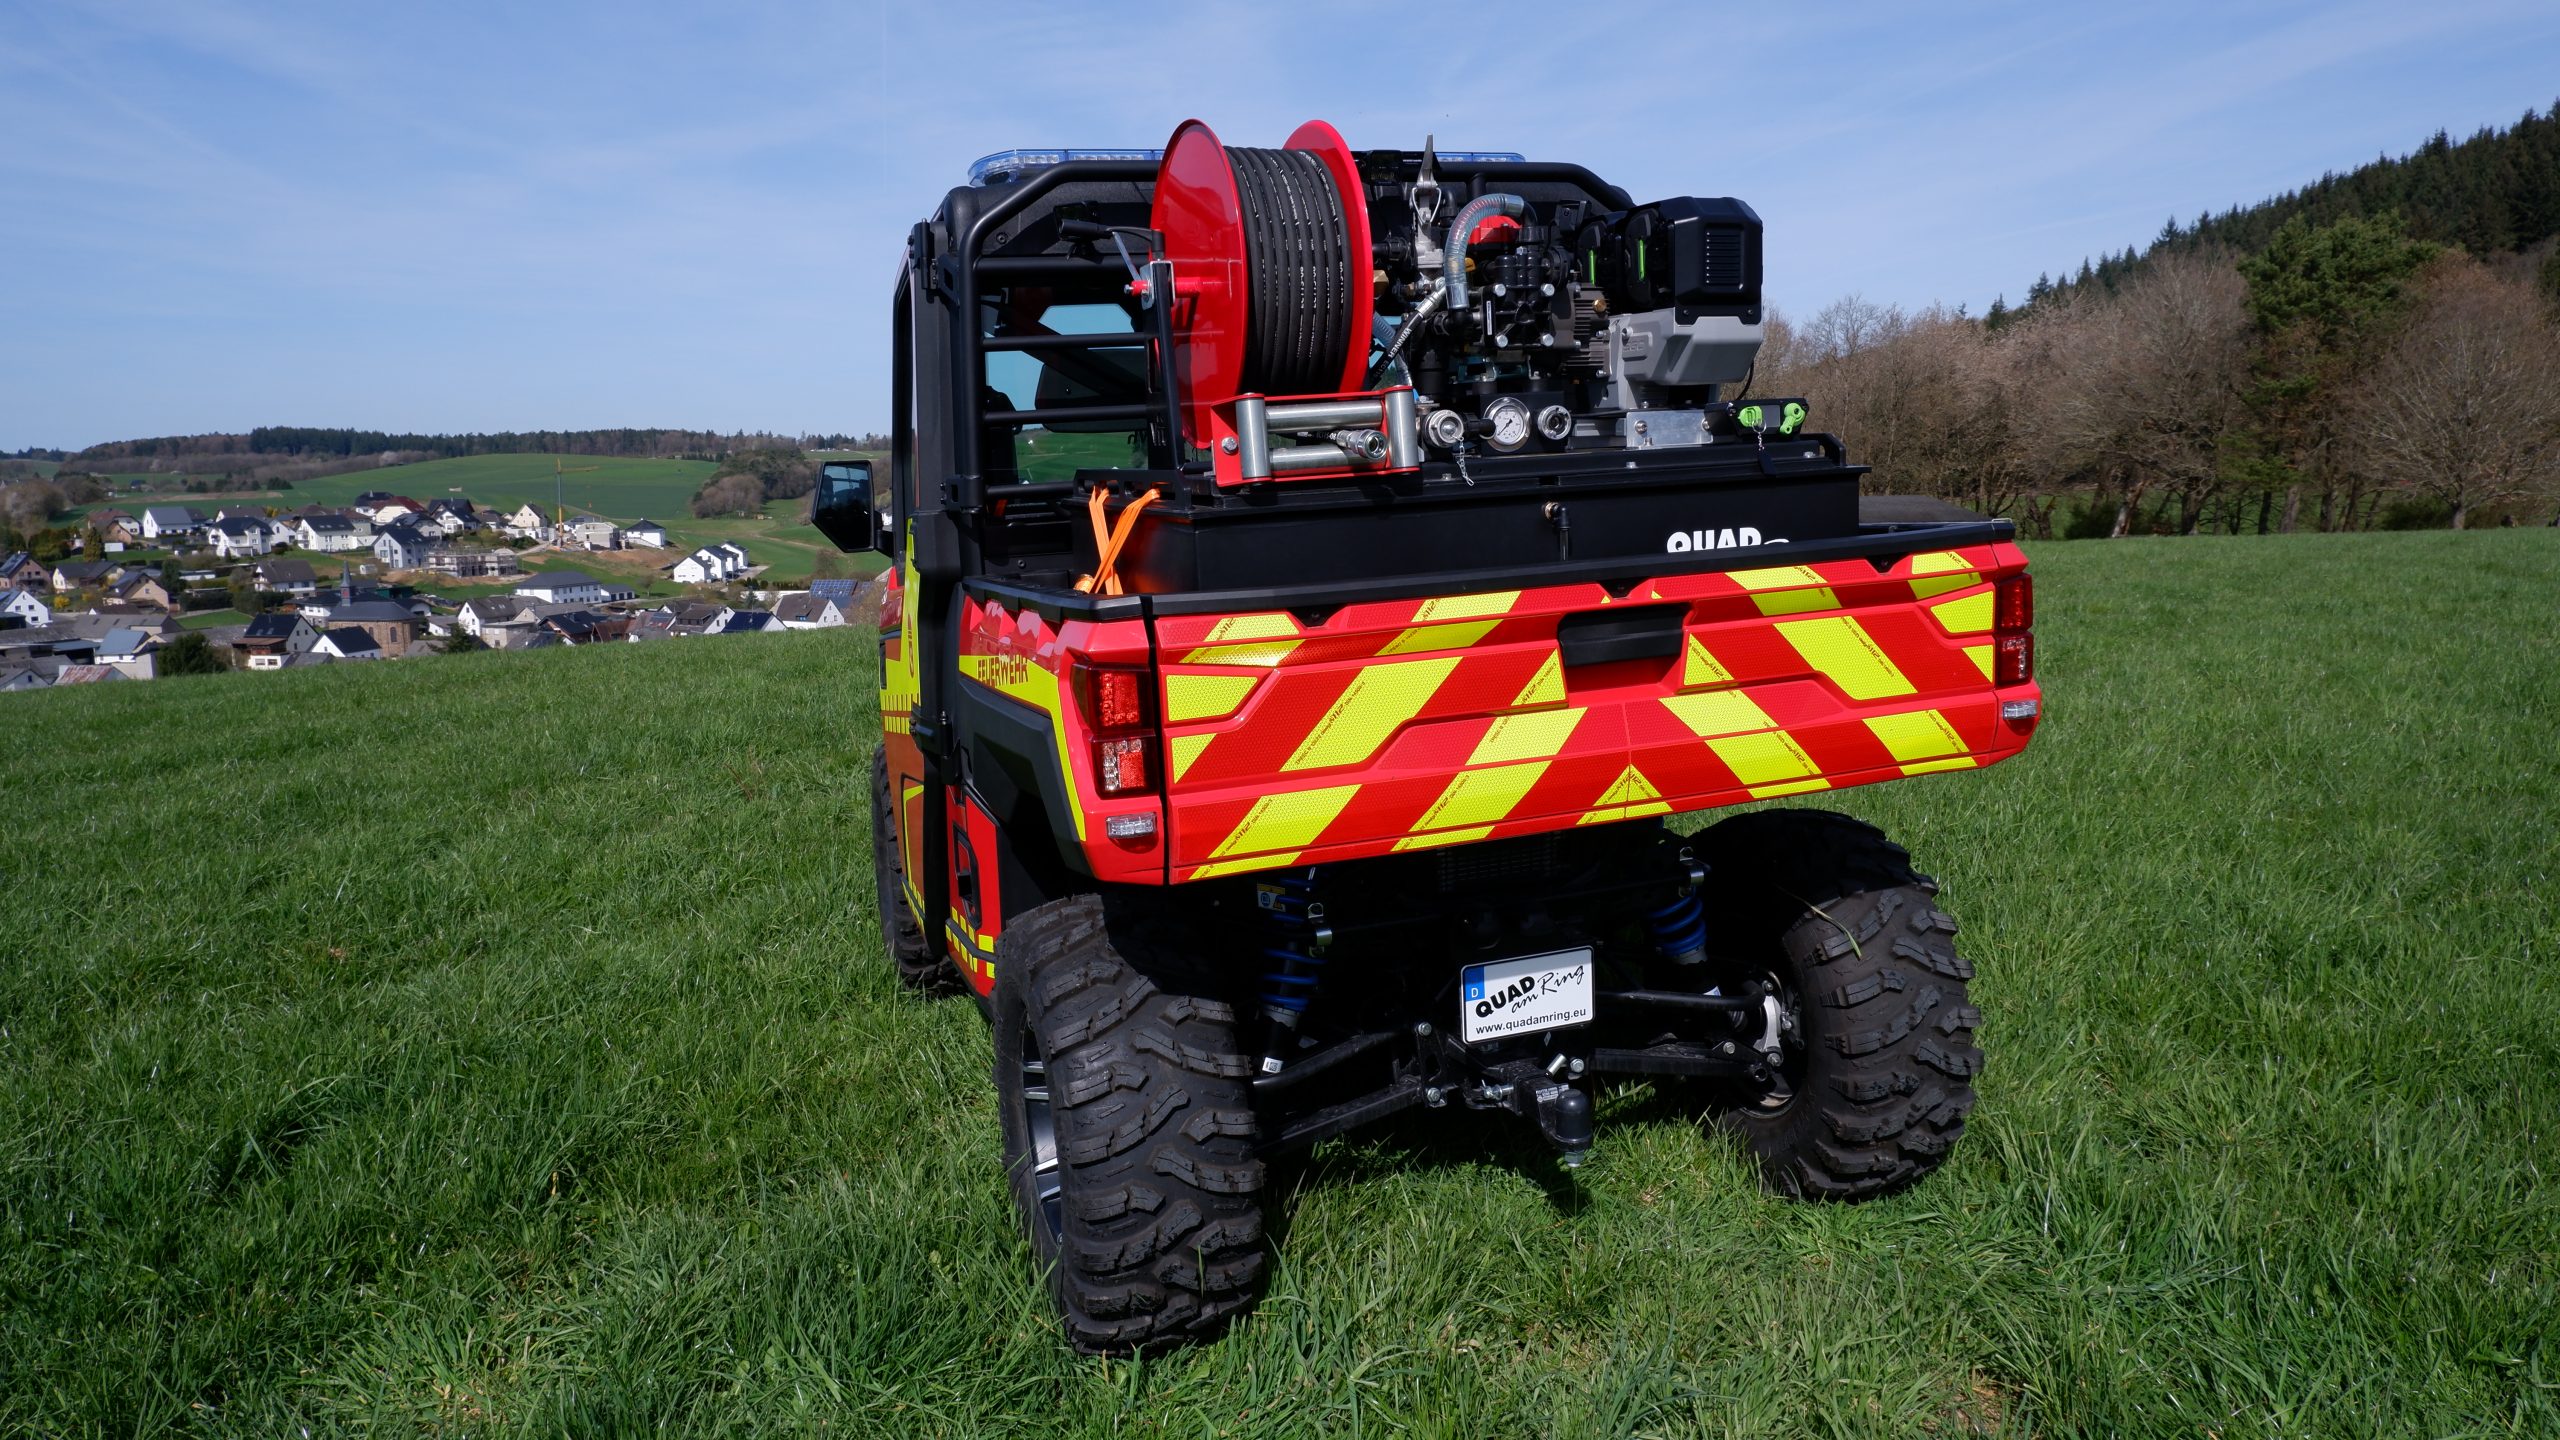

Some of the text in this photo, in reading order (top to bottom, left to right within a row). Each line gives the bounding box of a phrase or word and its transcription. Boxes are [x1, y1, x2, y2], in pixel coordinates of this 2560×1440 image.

[1388, 328, 1412, 358] WINNER
[1667, 527, 1761, 553] QUAD
[978, 654, 1028, 687] FEUERWEHR
[1471, 987, 1479, 998] D
[1475, 965, 1585, 1018] QUAD am Ring
[1476, 1008, 1587, 1034] www.quadamring.eu
